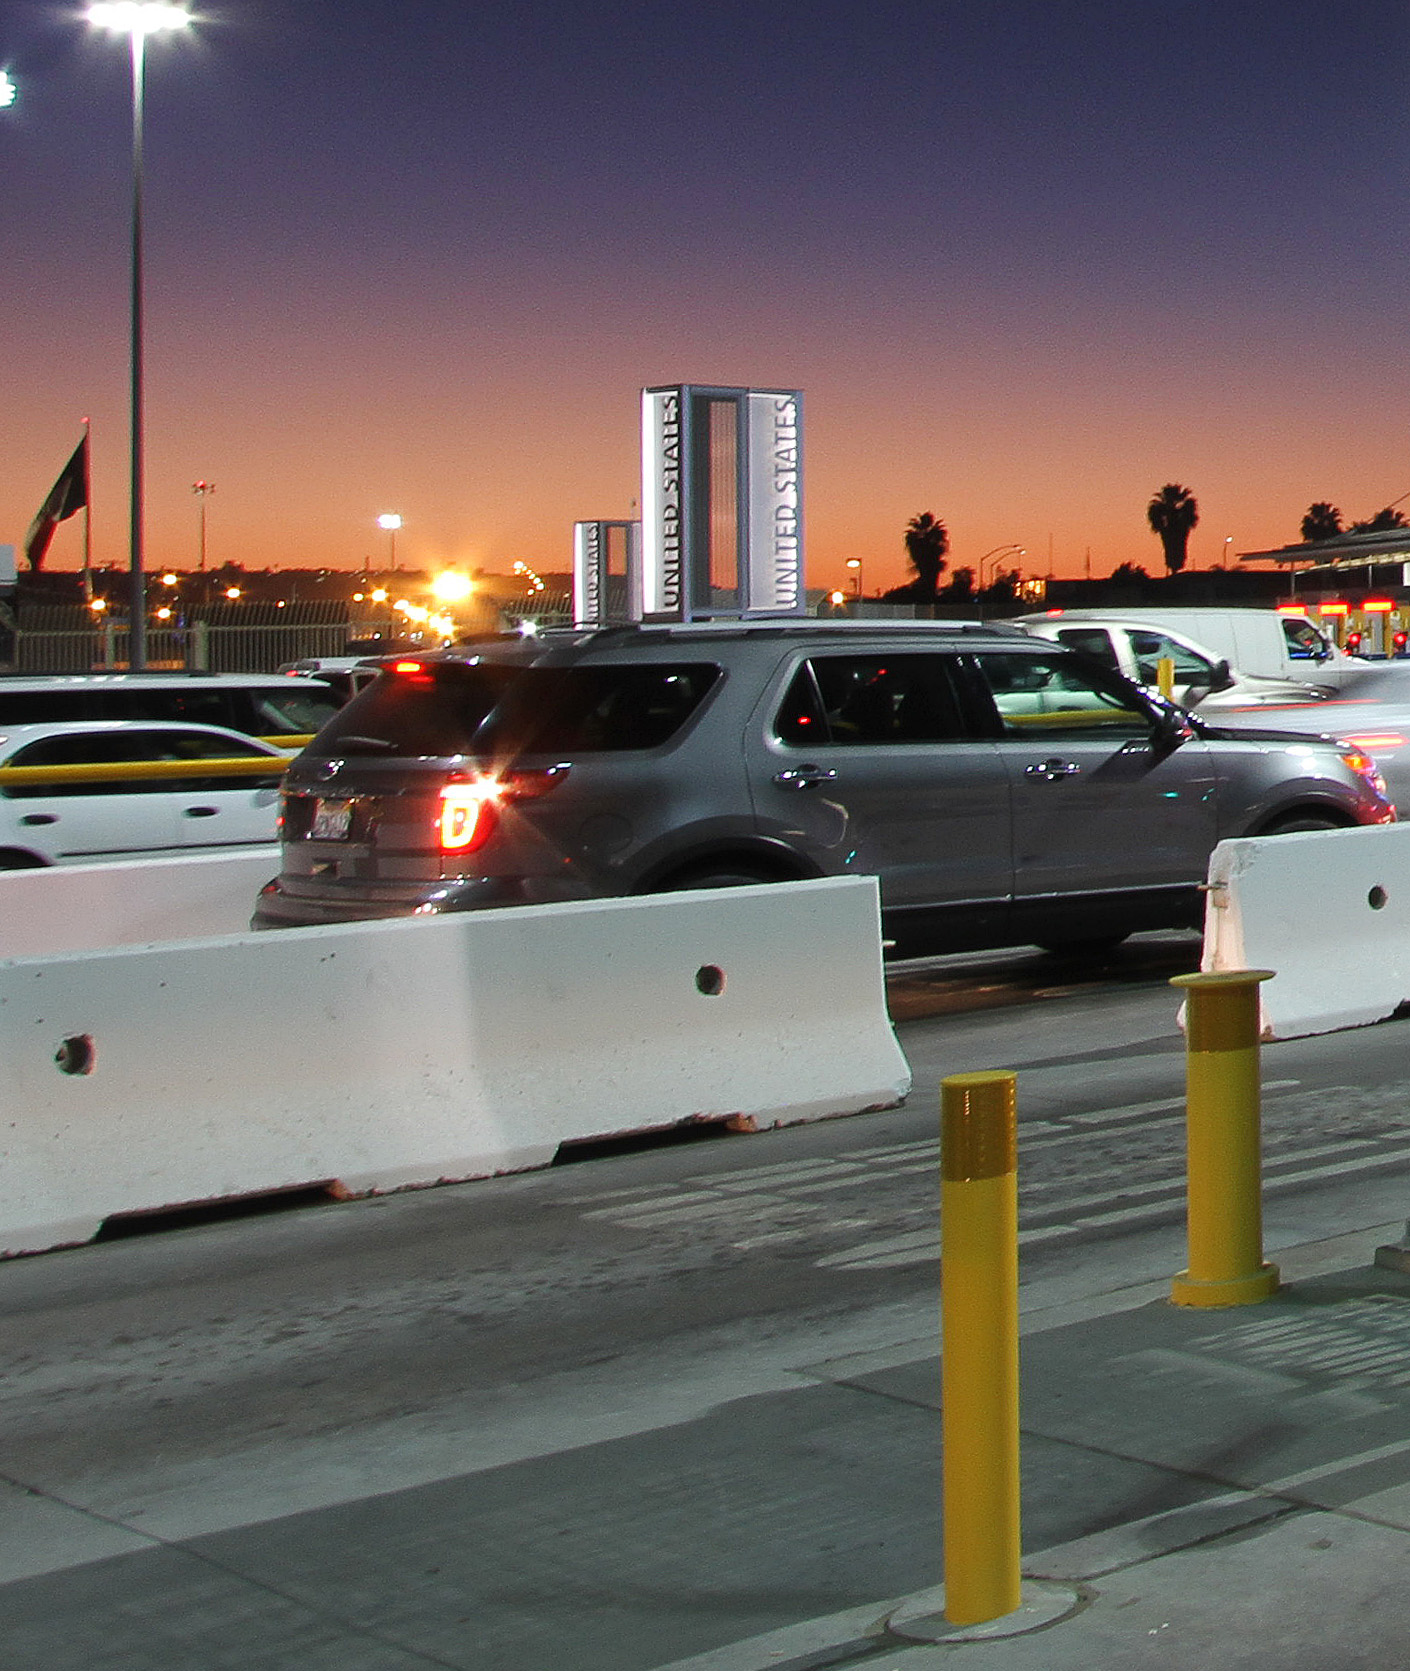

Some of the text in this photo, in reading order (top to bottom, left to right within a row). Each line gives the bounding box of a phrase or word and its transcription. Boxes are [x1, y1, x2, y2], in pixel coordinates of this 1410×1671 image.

[663, 394, 681, 608] UNITED STATES
[776, 396, 798, 610] UNITED STATES
